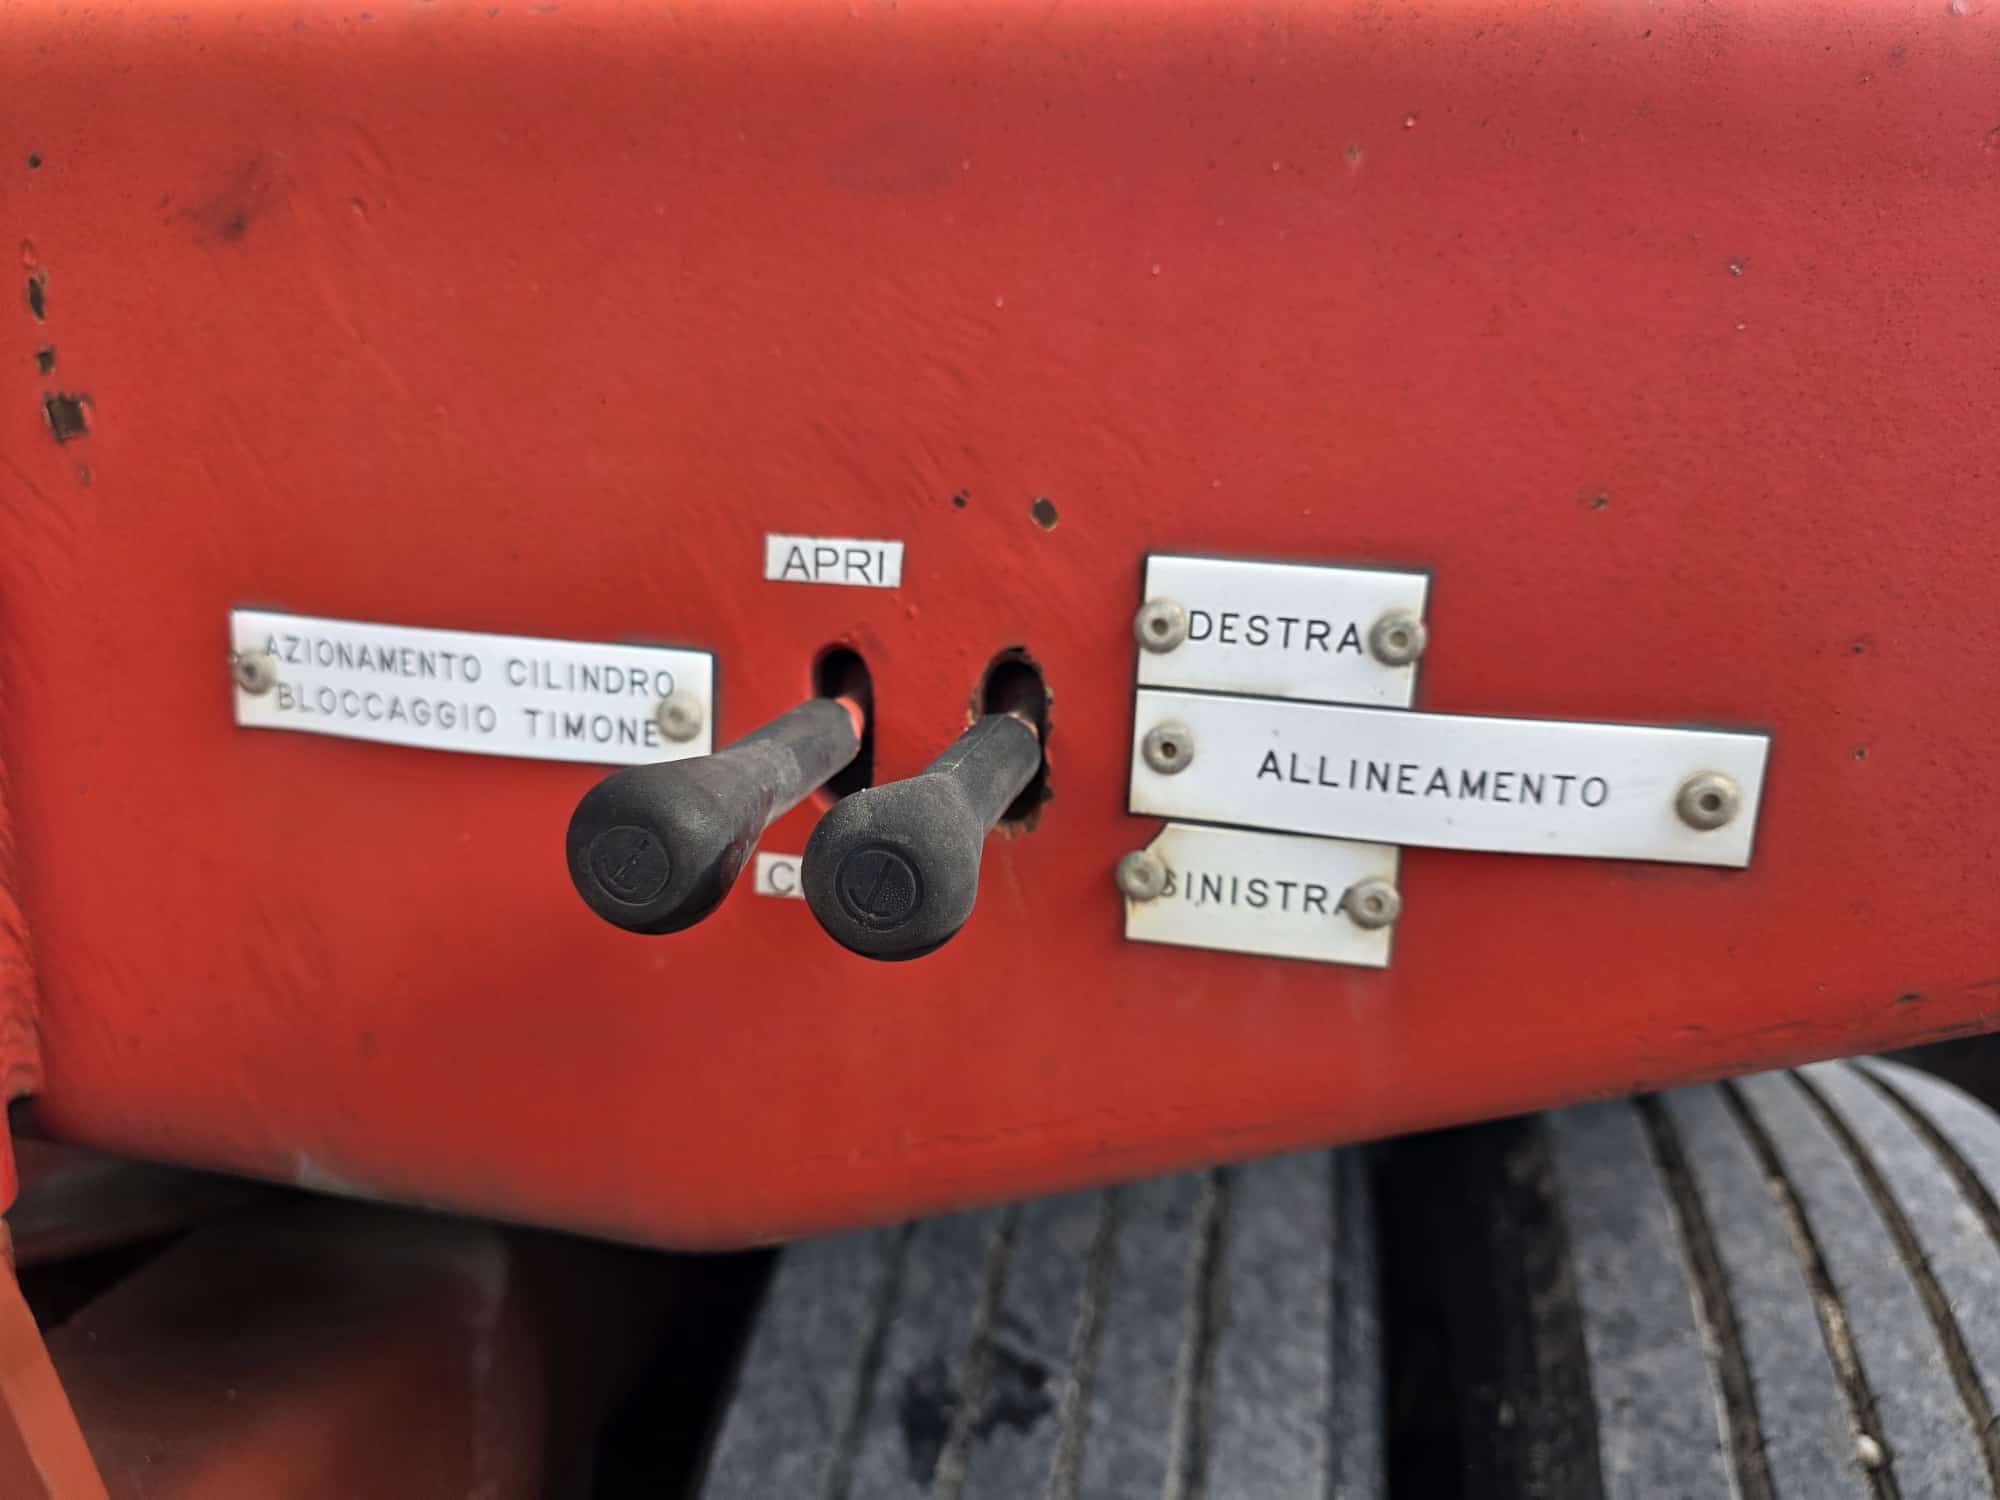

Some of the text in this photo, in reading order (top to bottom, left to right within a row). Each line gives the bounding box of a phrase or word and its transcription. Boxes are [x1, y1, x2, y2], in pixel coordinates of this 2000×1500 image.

[782, 545, 884, 584] APRI
[1187, 609, 1363, 655] DESTRA
[264, 634, 675, 697] AZIONAMENTO CILINDRO
[276, 681, 662, 748] BLOCCAGGIO TIMONE
[1256, 749, 1610, 808] ALLINEAMENTO
